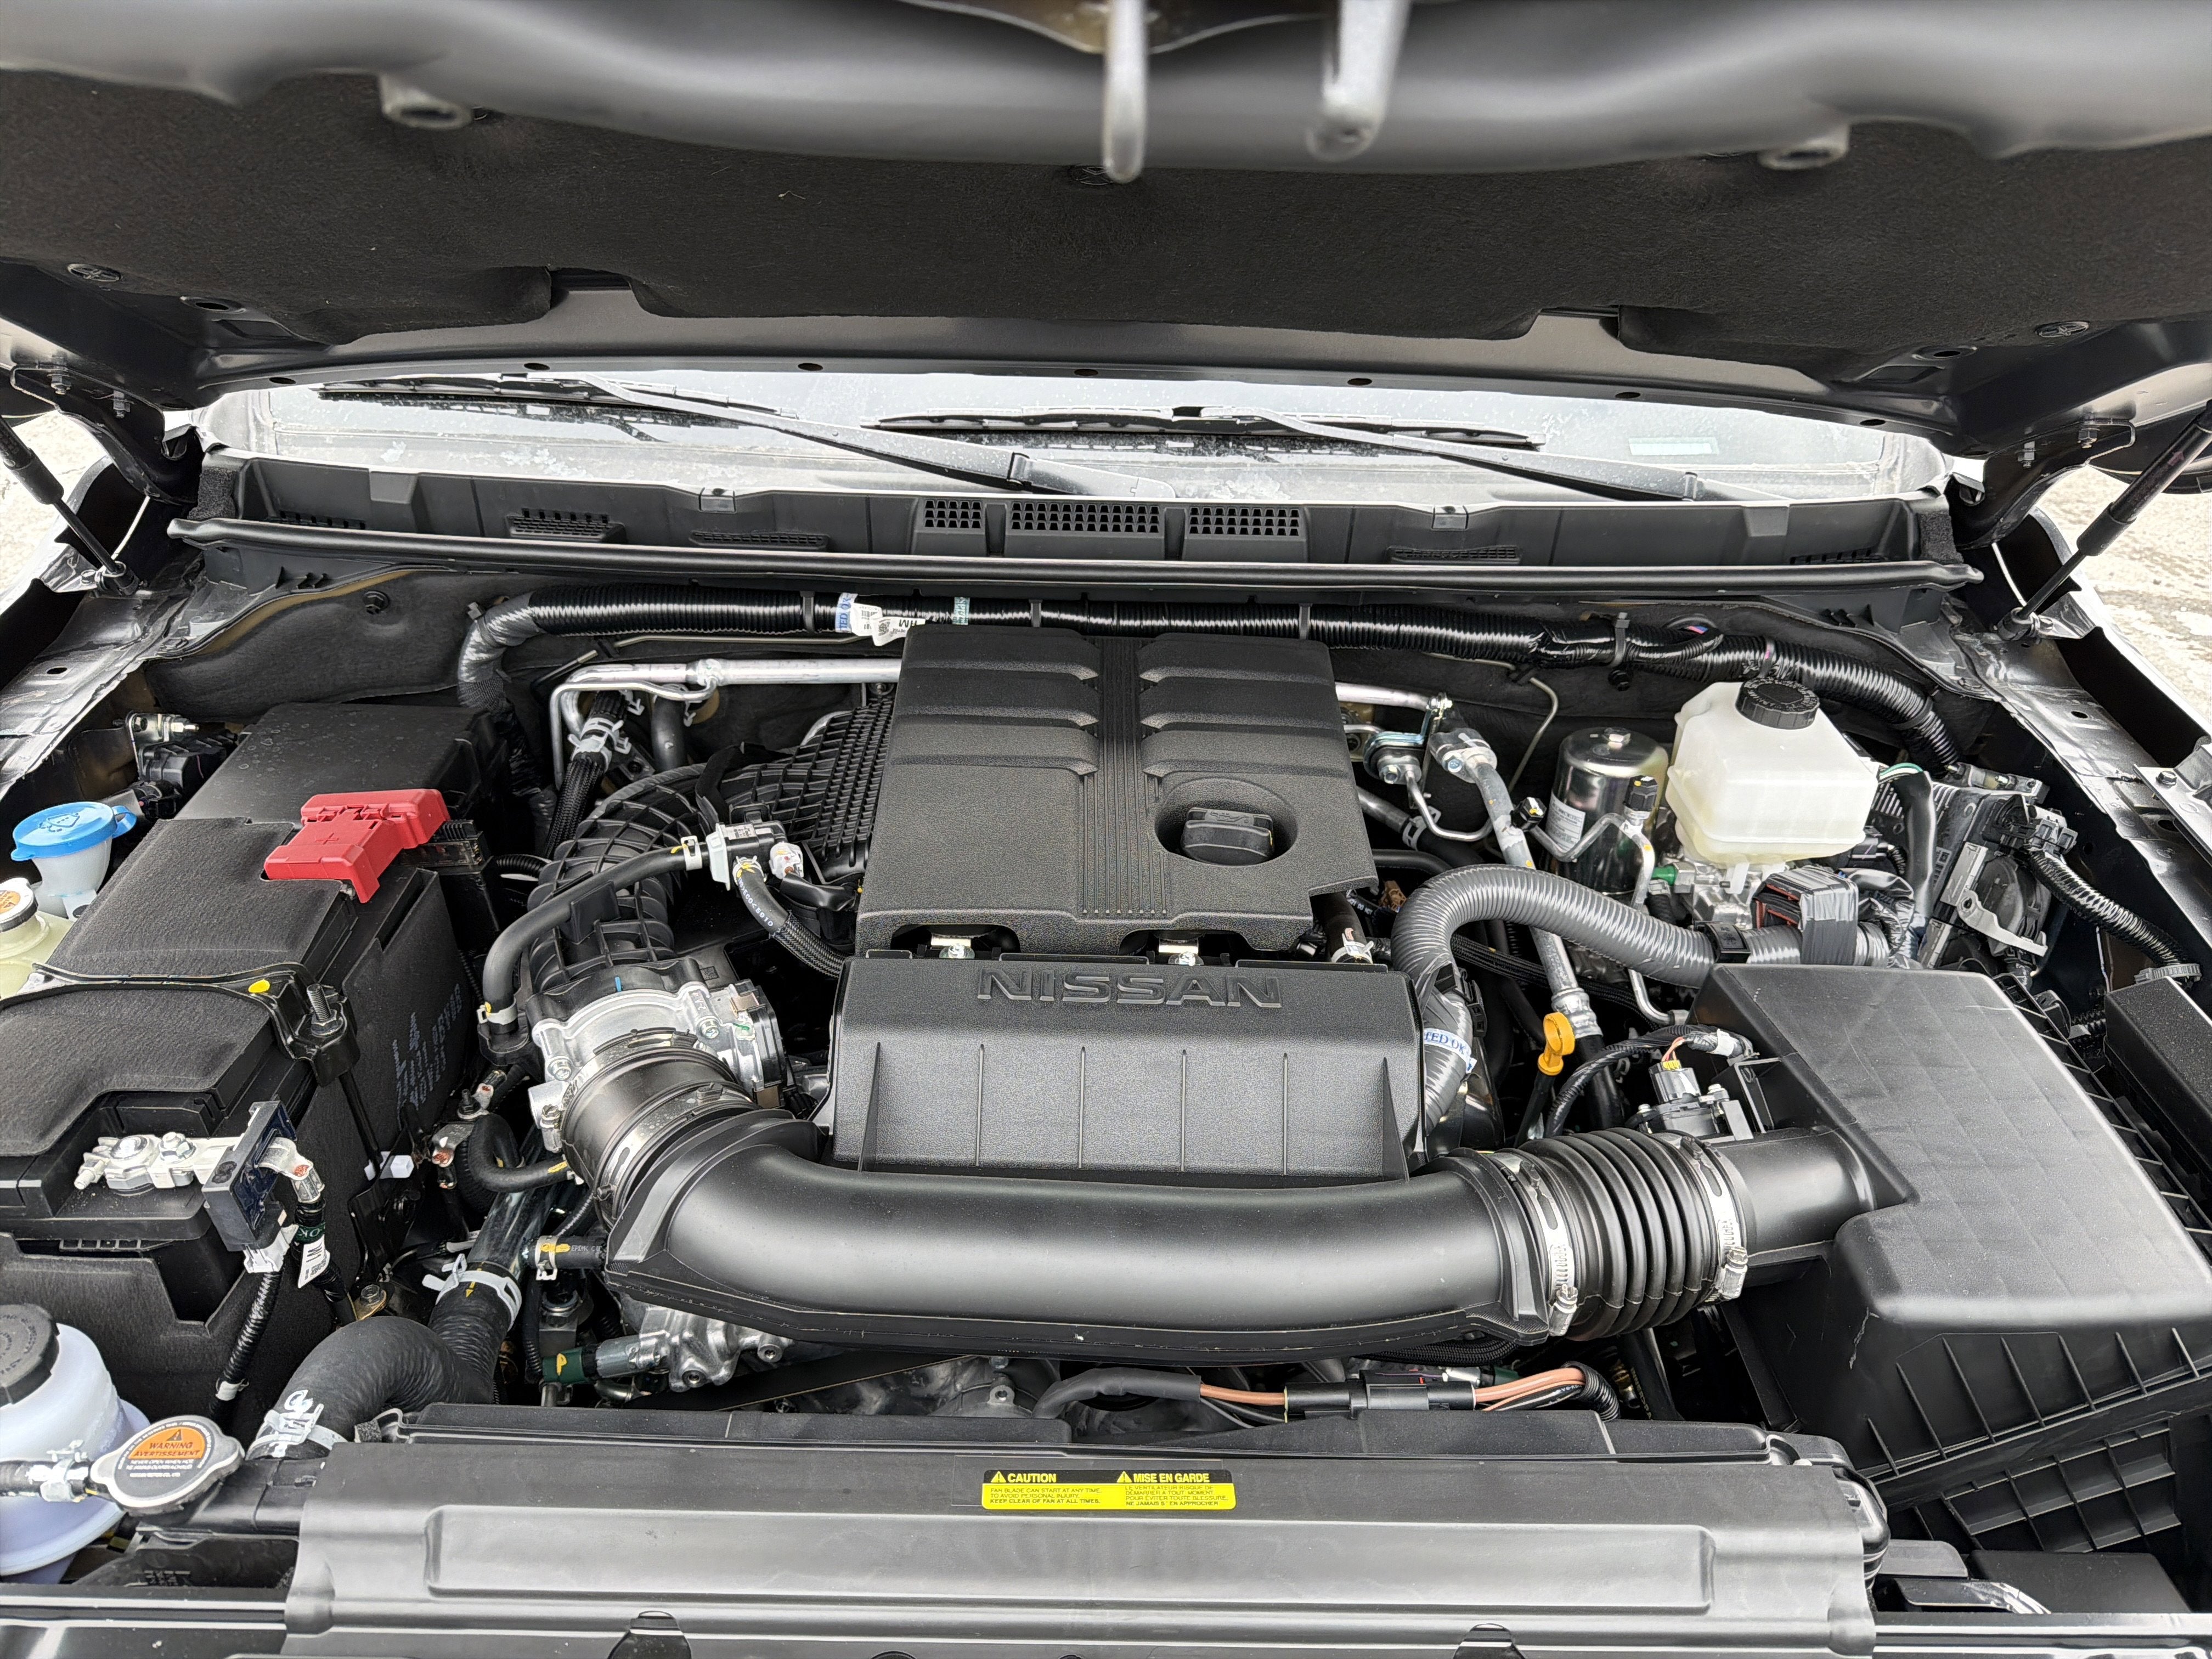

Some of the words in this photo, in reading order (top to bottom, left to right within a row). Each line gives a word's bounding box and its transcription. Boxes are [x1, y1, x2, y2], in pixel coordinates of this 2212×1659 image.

[977, 968, 1282, 1008] NISSAN
[1451, 1039, 1466, 1055] OK
[1007, 1473, 1057, 1483] CAUTION
[1133, 1473, 1158, 1483] MISE
[1159, 1473, 1173, 1483] EN
[1175, 1473, 1210, 1483] GARDE
